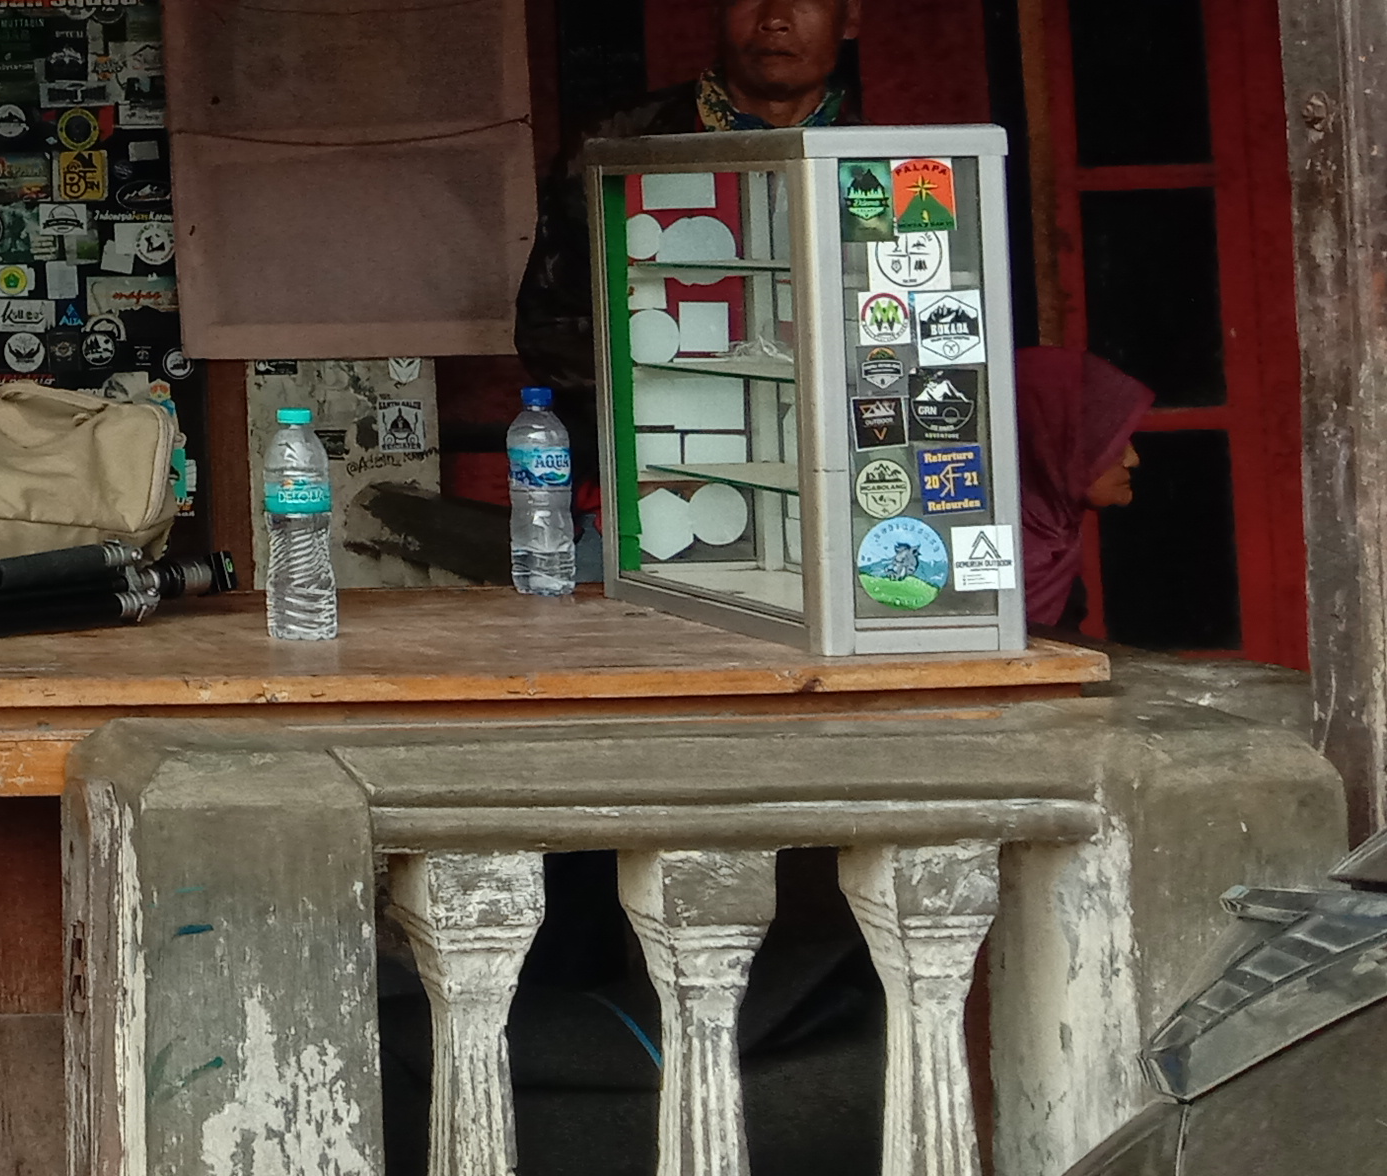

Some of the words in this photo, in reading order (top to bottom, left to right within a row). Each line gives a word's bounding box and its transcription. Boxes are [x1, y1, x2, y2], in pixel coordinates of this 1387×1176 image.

[894, 164, 948, 177] PALAPA
[534, 454, 570, 472] AQUA
[924, 476, 940, 489] 20
[964, 471, 979, 485] 21
